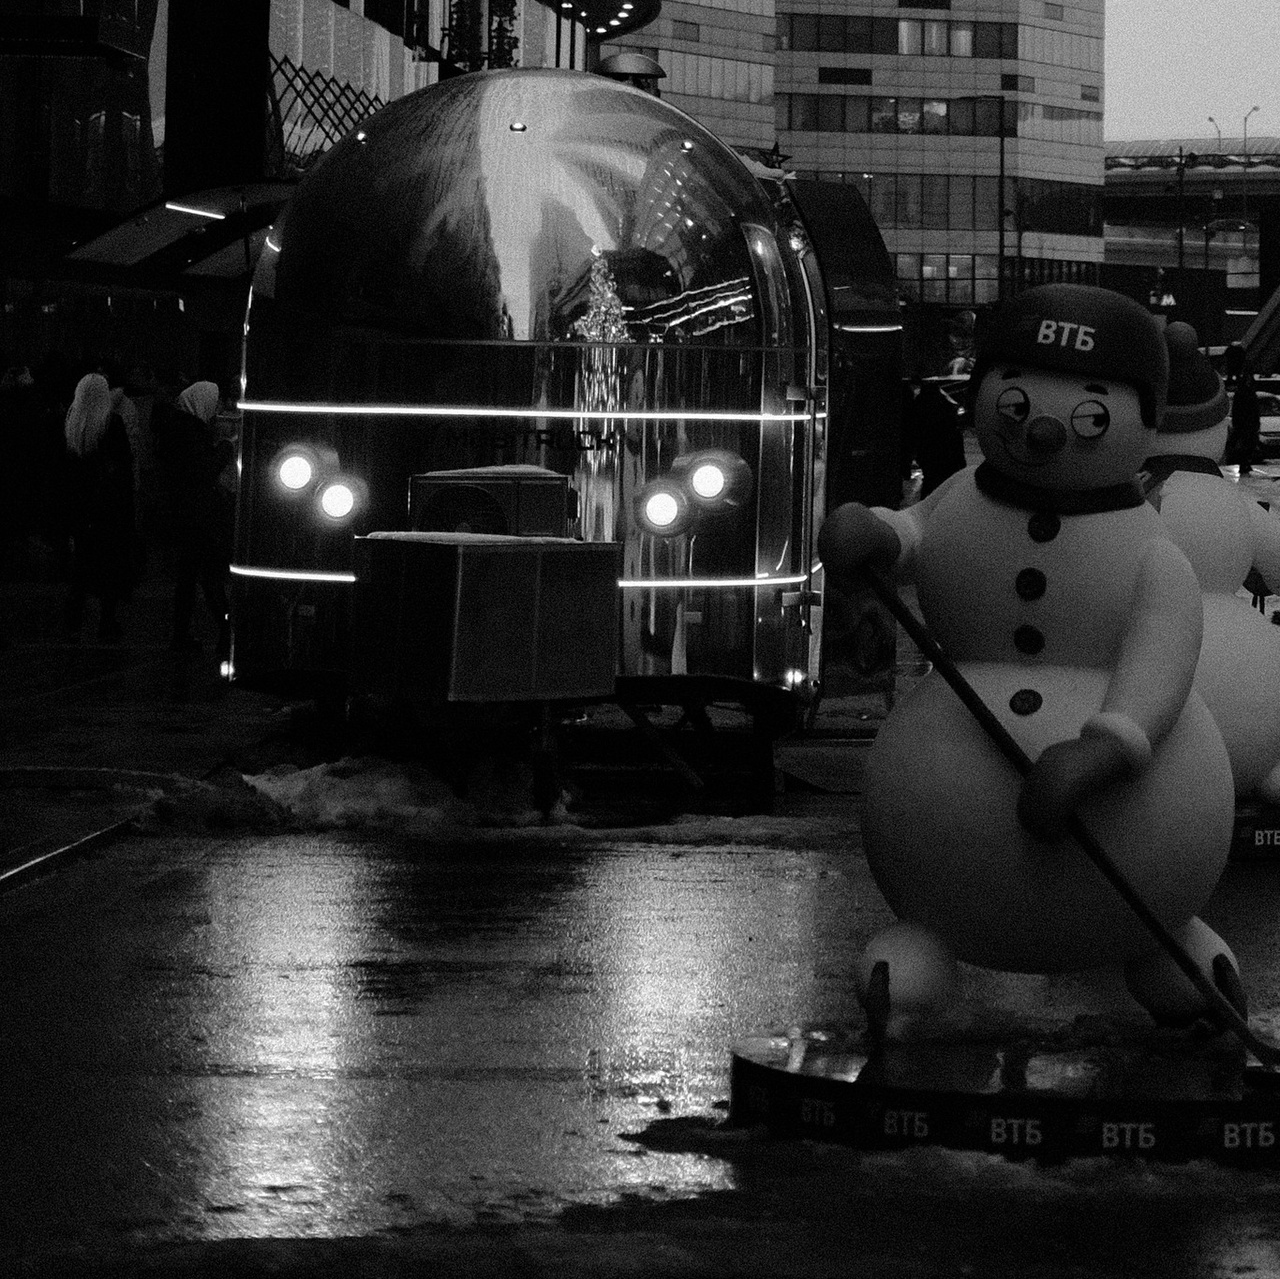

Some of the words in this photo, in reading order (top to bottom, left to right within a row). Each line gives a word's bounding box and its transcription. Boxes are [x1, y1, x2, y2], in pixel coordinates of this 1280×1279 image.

[1036, 318, 1096, 352] ВТБ
[802, 1098, 836, 1127] ВТБ
[885, 1110, 930, 1138] ВТБ
[991, 1118, 1042, 1145] ВТБ
[1102, 1122, 1156, 1149] ВТБ
[1224, 1122, 1276, 1148] ВТБ
